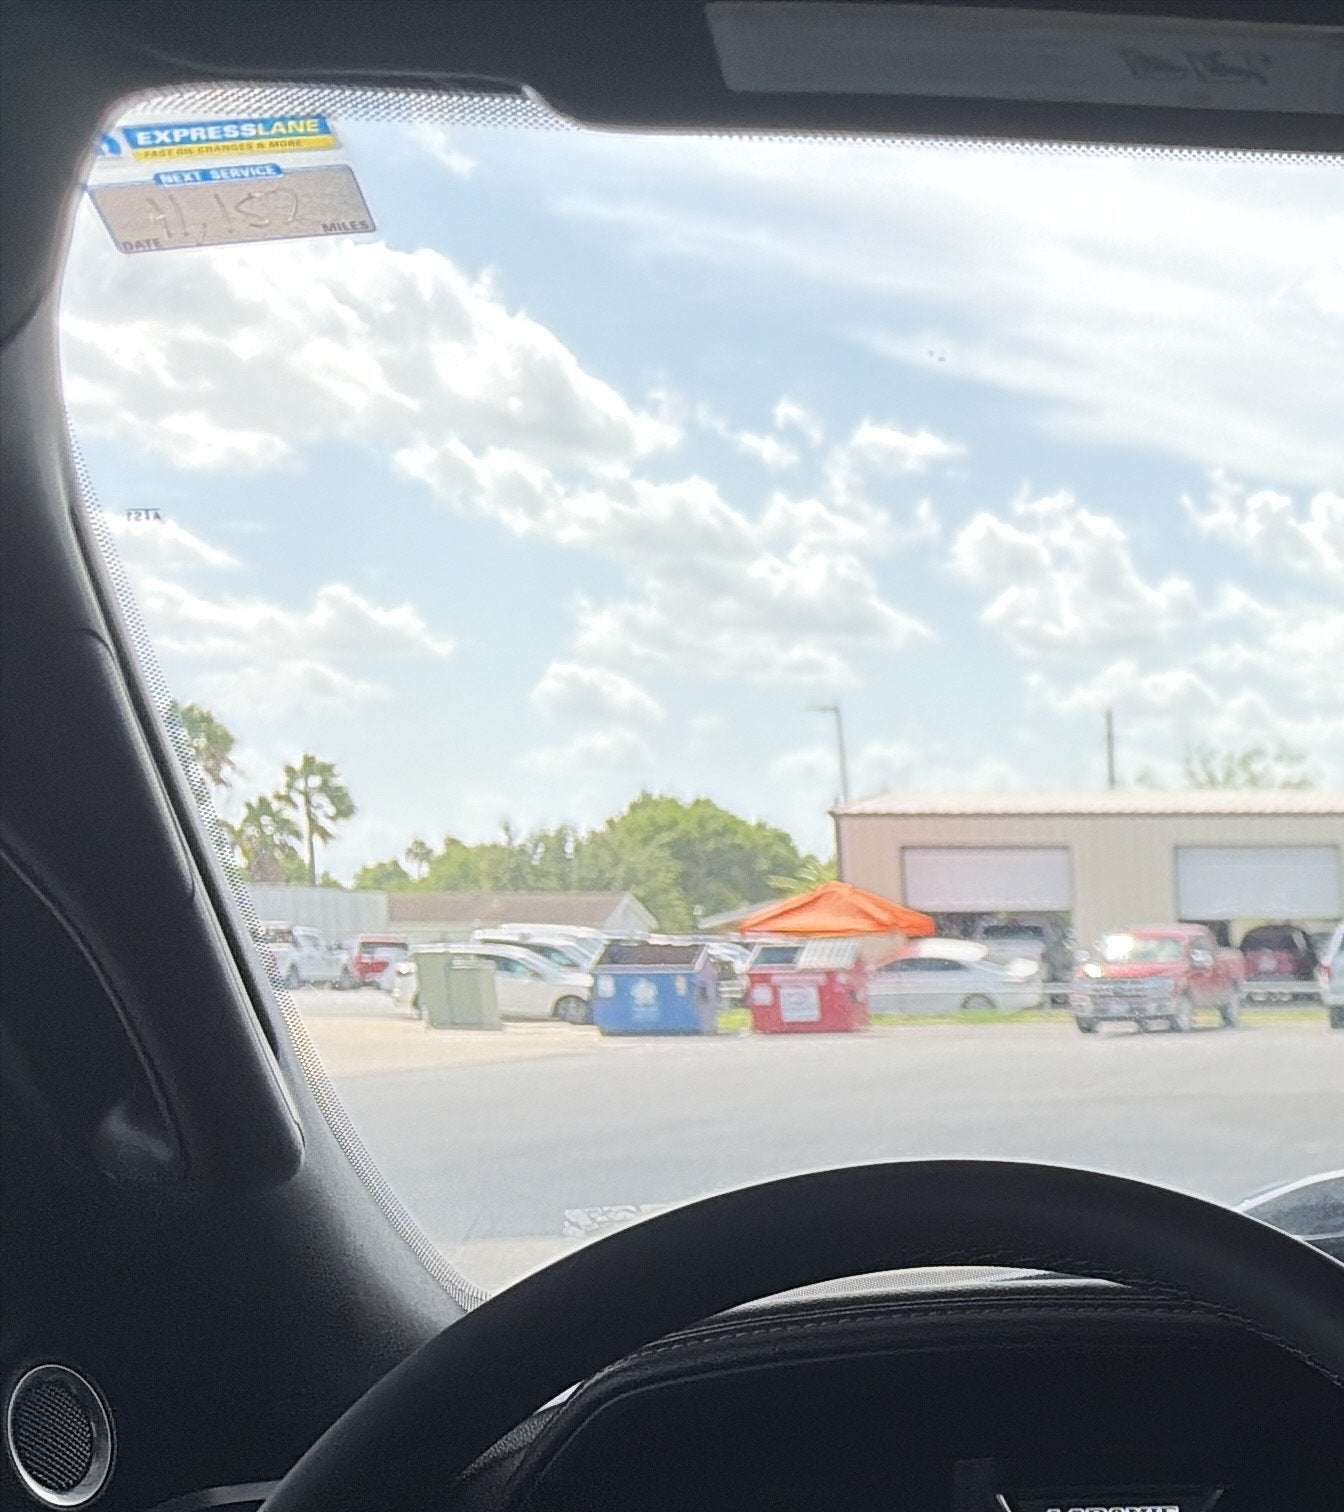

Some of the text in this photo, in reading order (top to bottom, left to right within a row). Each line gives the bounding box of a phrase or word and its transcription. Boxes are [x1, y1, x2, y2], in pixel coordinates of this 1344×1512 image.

[136, 119, 320, 146] EXPRESSLANE
[268, 138, 301, 149] MORE
[160, 165, 274, 185] NEXT SERVICE
[322, 220, 370, 233] MILES
[122, 239, 162, 252] DATE
